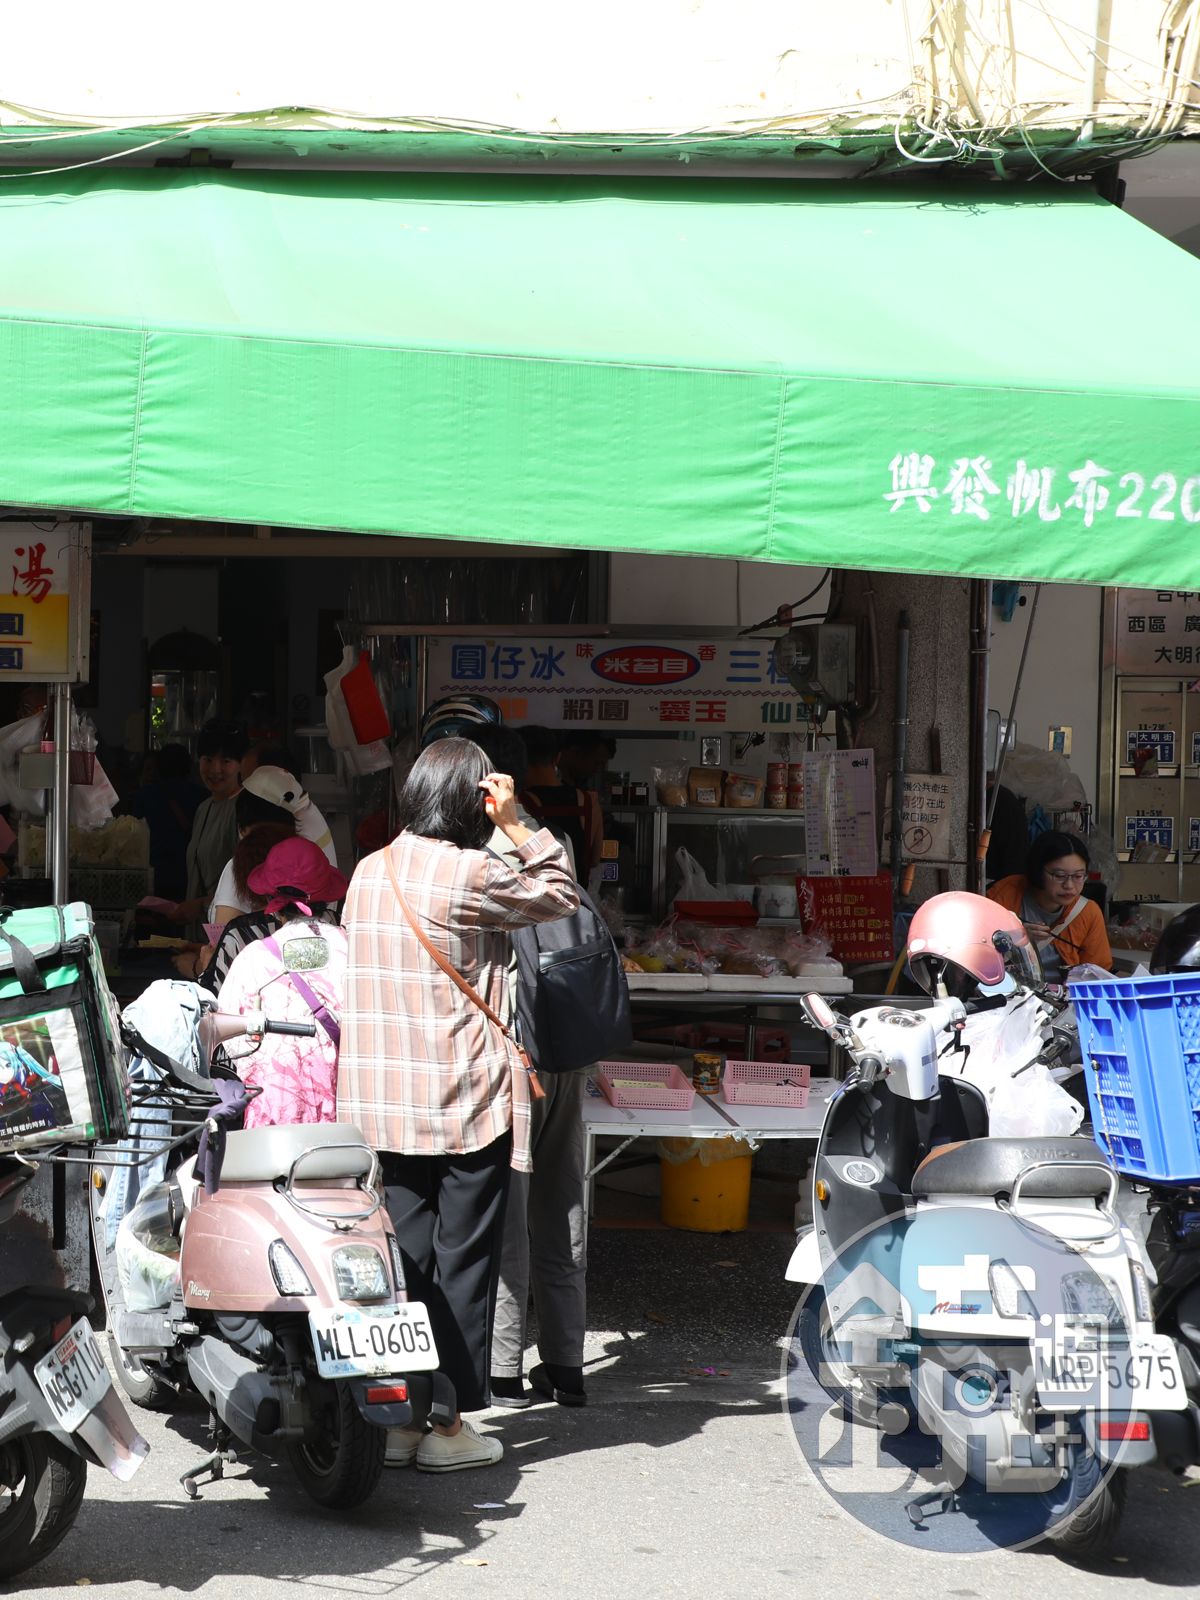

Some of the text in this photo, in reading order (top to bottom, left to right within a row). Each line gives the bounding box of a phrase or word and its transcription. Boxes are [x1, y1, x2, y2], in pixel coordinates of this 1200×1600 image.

[1128, 615, 1167, 633] 西區
[451, 644, 566, 682] 圓仔冰
[576, 642, 593, 659] 味
[603, 656, 690, 675] 米苔目
[697, 644, 717, 662] 香
[1154, 646, 1200, 664] 大明
[562, 699, 629, 722] 粉圓
[659, 700, 728, 723] 愛玉
[926, 798, 946, 810] 在此
[1143, 830, 1161, 847] 11
